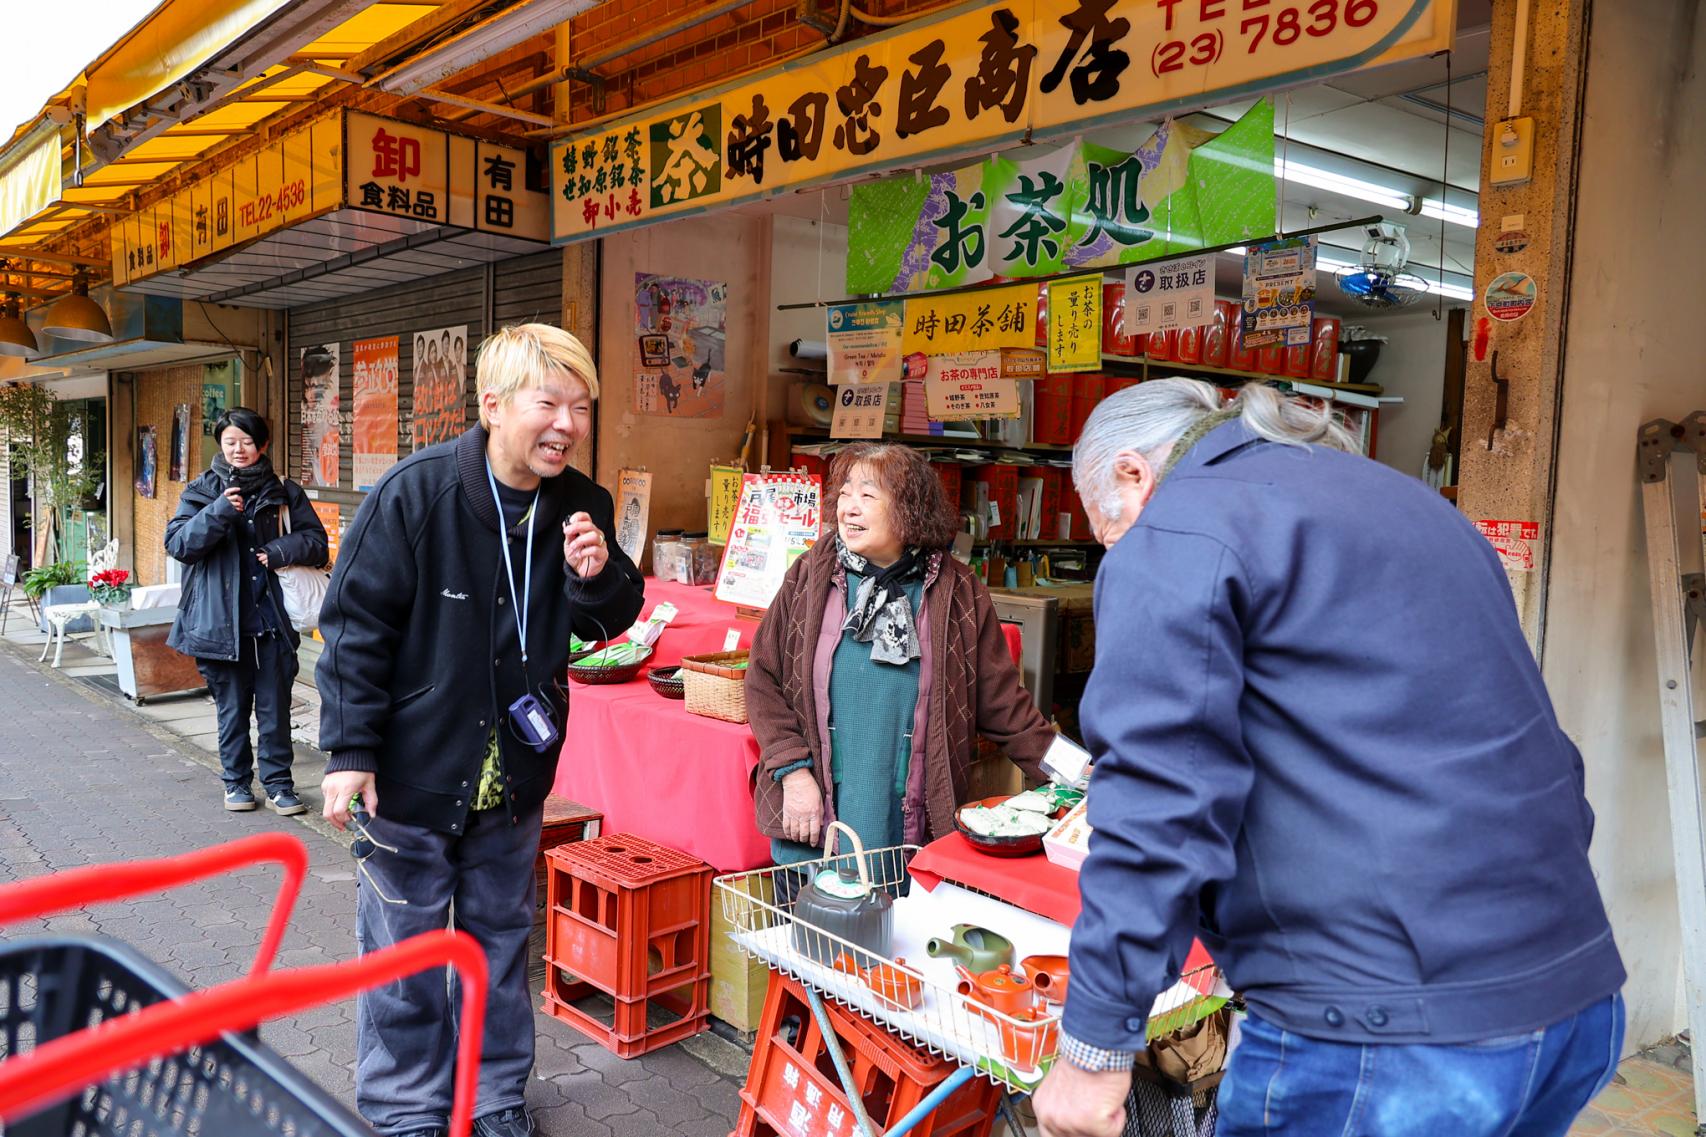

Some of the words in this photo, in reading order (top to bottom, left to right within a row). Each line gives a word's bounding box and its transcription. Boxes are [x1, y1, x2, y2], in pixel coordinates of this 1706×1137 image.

[1157, 0, 1271, 31] TE
[1151, 28, 1225, 79] (23)
[1240, 0, 1379, 54] 7836
[725, 0, 1131, 184] 時田忠臣商店
[371, 127, 421, 182] 卸
[562, 126, 643, 174] 嬉野銘茶
[652, 111, 720, 204] 茶
[359, 181, 437, 219] 食料品
[483, 154, 516, 228] 有田
[582, 188, 643, 231] 卸小売
[195, 196, 229, 246] 有田
[930, 156, 1155, 274] お茶処
[129, 243, 153, 272] 食料品
[159, 221, 170, 260] 卸
[1159, 269, 1207, 291] 取扱店
[912, 302, 1028, 341] 時田茶舗
[1067, 290, 1081, 355] 量り売り
[1082, 285, 1096, 330] お茶の
[353, 357, 399, 395] 参政党
[940, 366, 999, 382] お茶の専門店
[722, 478, 730, 531] 量り売り
